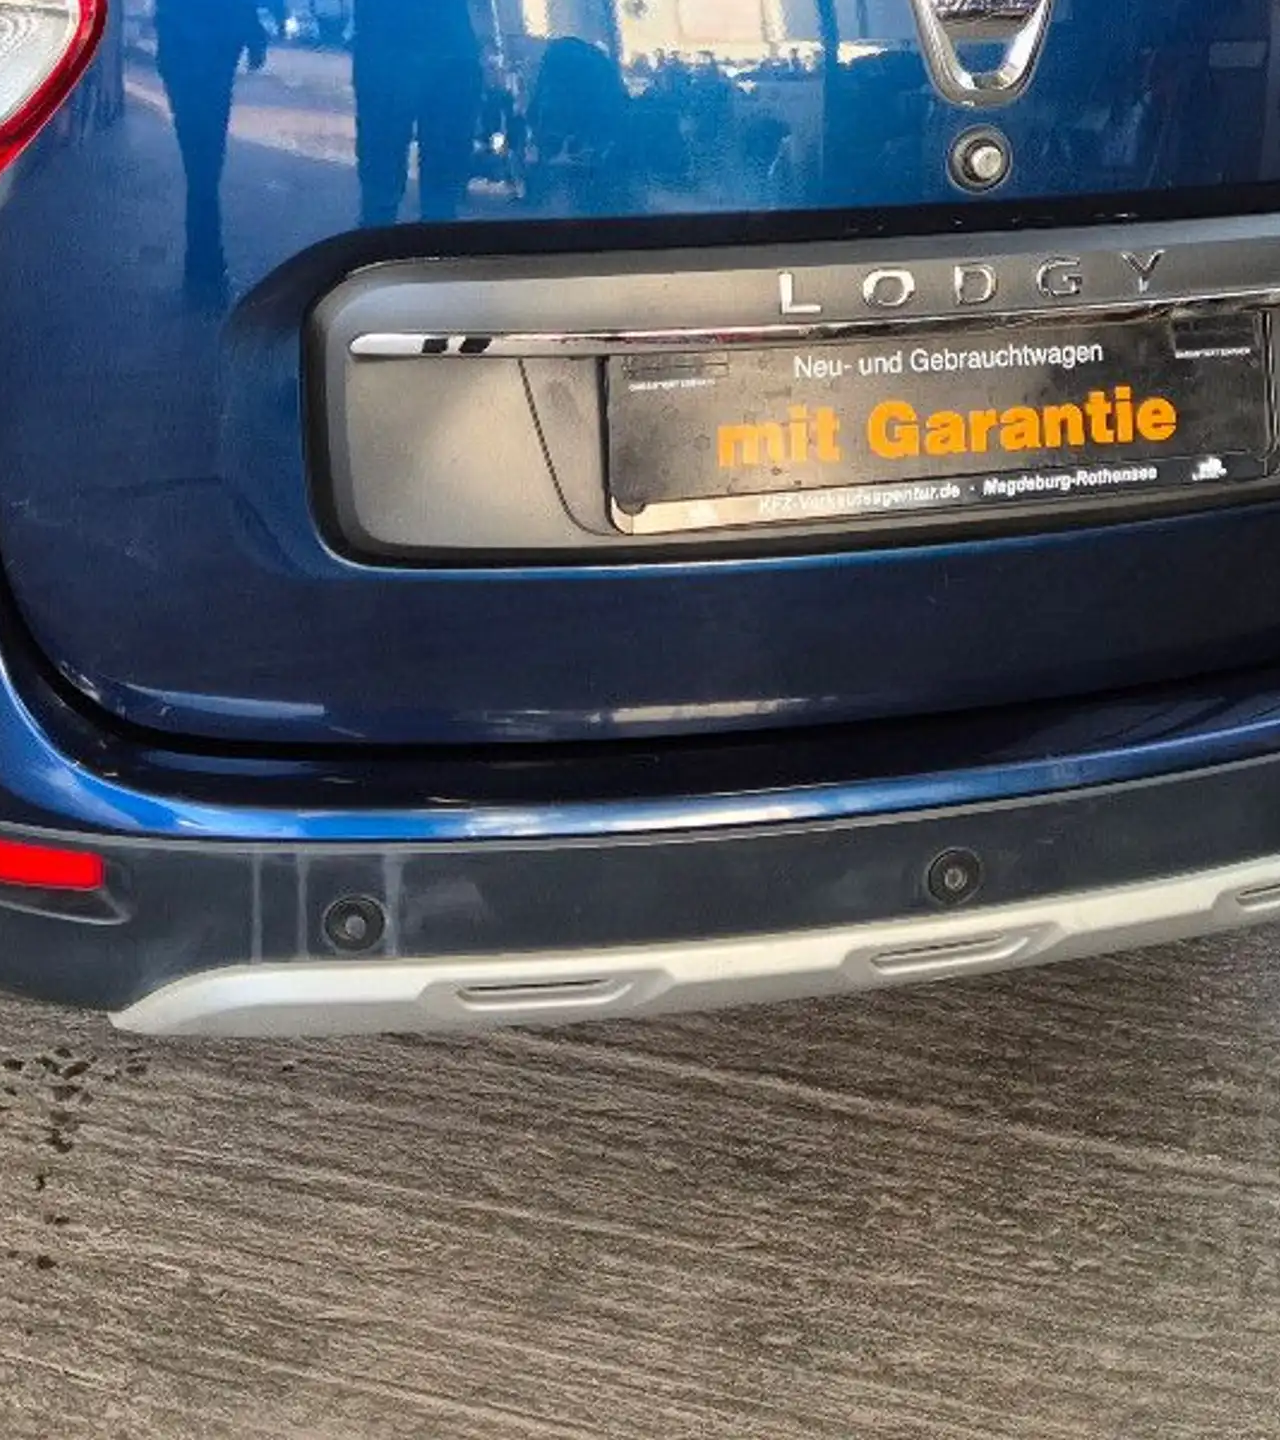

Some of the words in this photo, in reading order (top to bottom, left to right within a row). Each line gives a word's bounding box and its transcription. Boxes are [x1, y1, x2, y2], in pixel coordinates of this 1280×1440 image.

[777, 248, 1167, 315] LODGY
[794, 355, 851, 378] Neu-
[858, 350, 903, 375] und
[910, 342, 1104, 373] Gebrauchtwagen
[717, 404, 840, 467] mit
[867, 386, 1177, 458] Garantie
[983, 466, 1158, 497] Magdeburg-Rothensee
